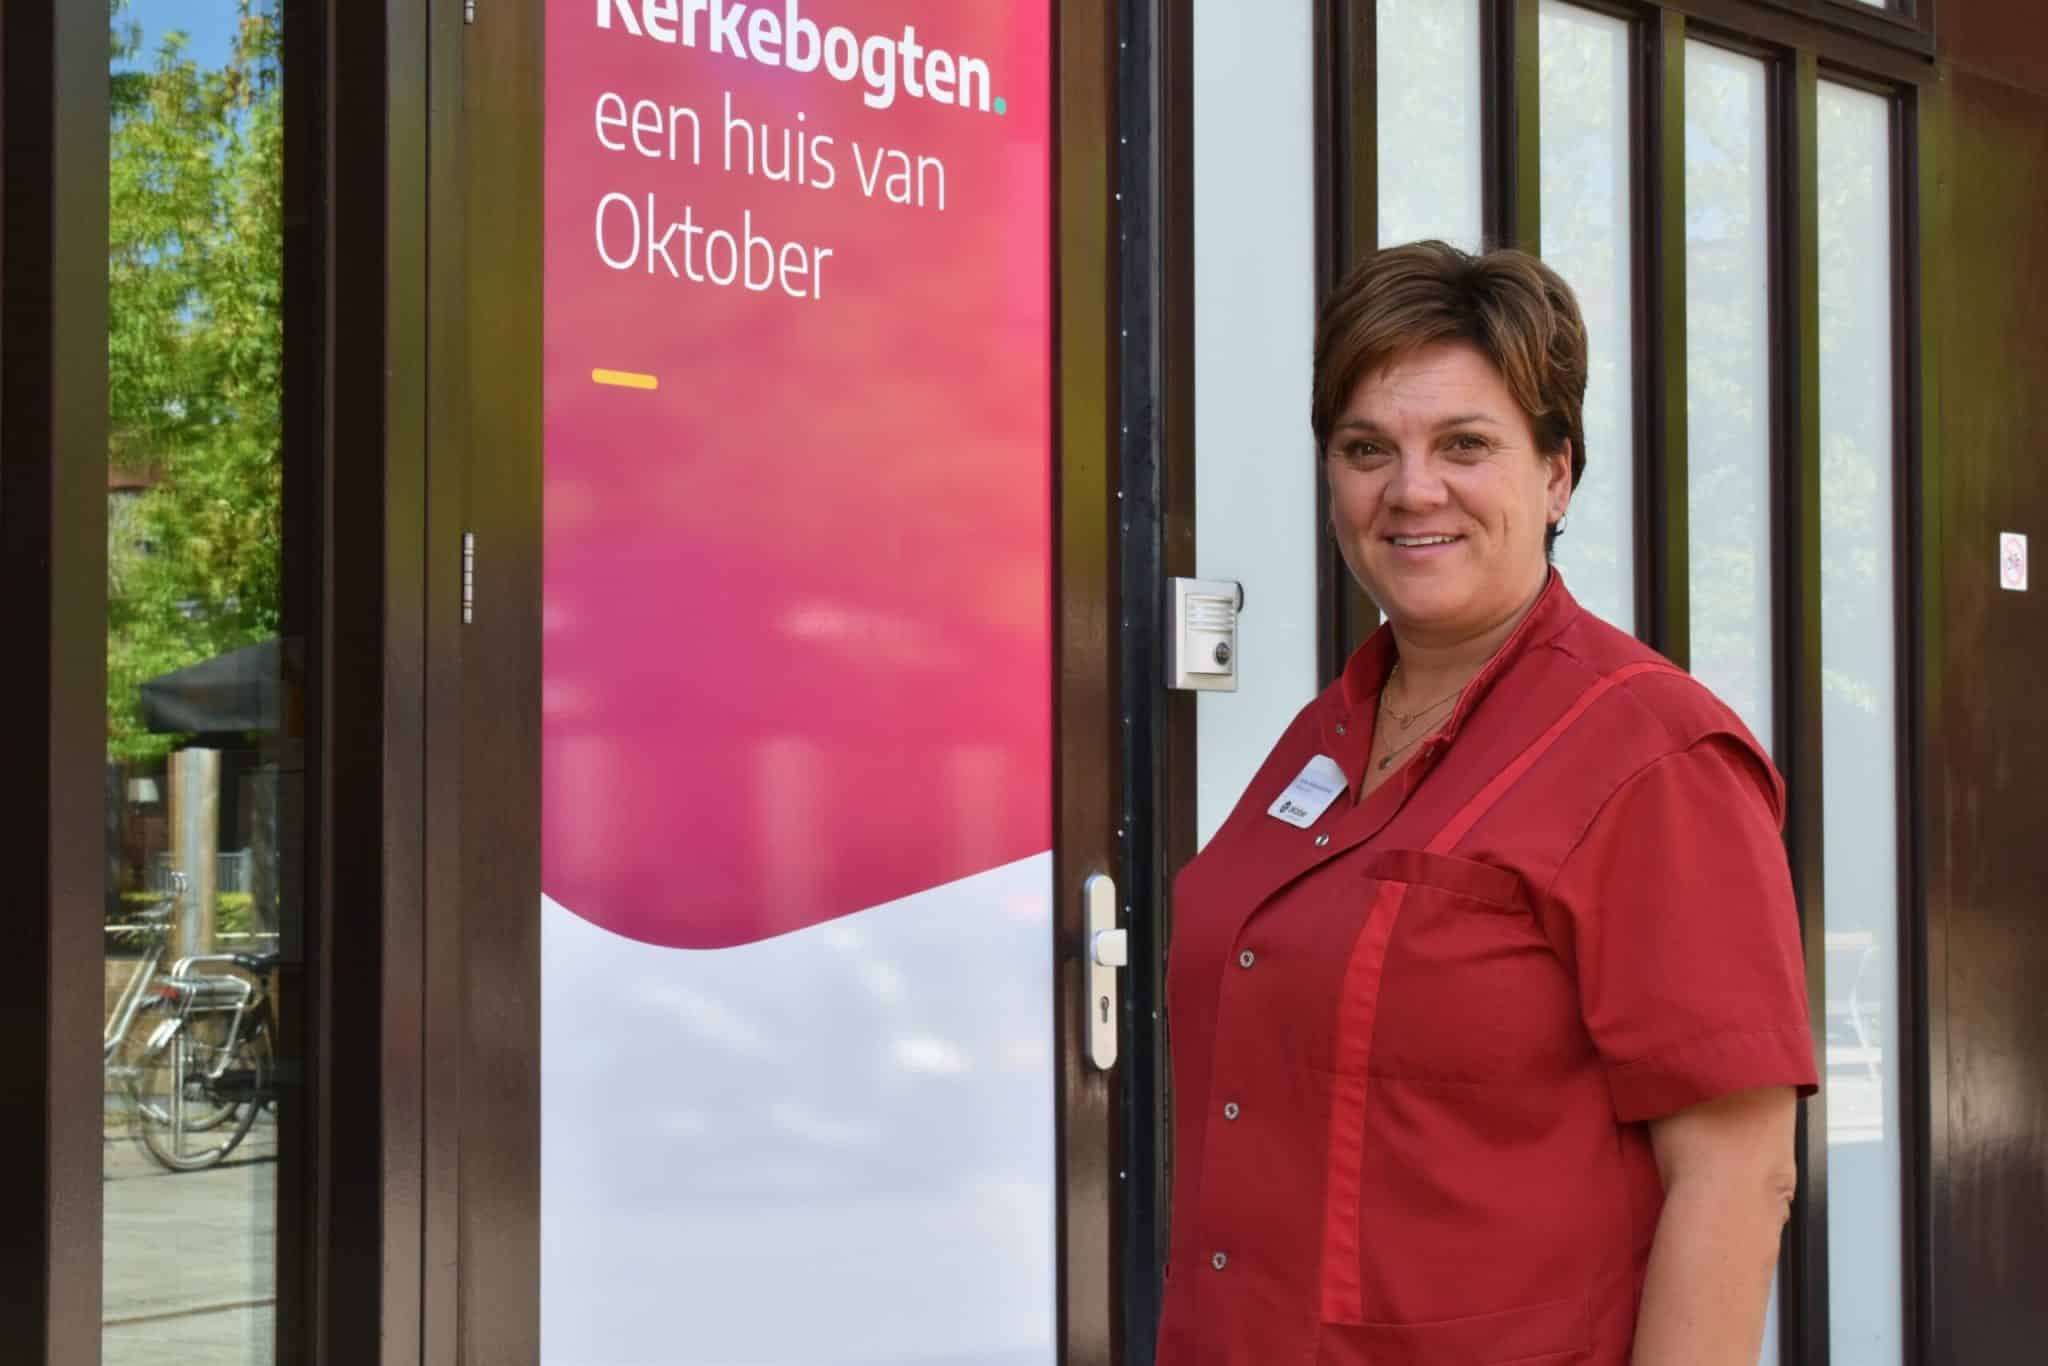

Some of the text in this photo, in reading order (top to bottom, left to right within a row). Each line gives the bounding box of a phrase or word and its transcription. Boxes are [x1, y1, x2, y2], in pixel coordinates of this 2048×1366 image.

[595, 91, 945, 211] een huis van
[595, 192, 833, 300] Oktober
